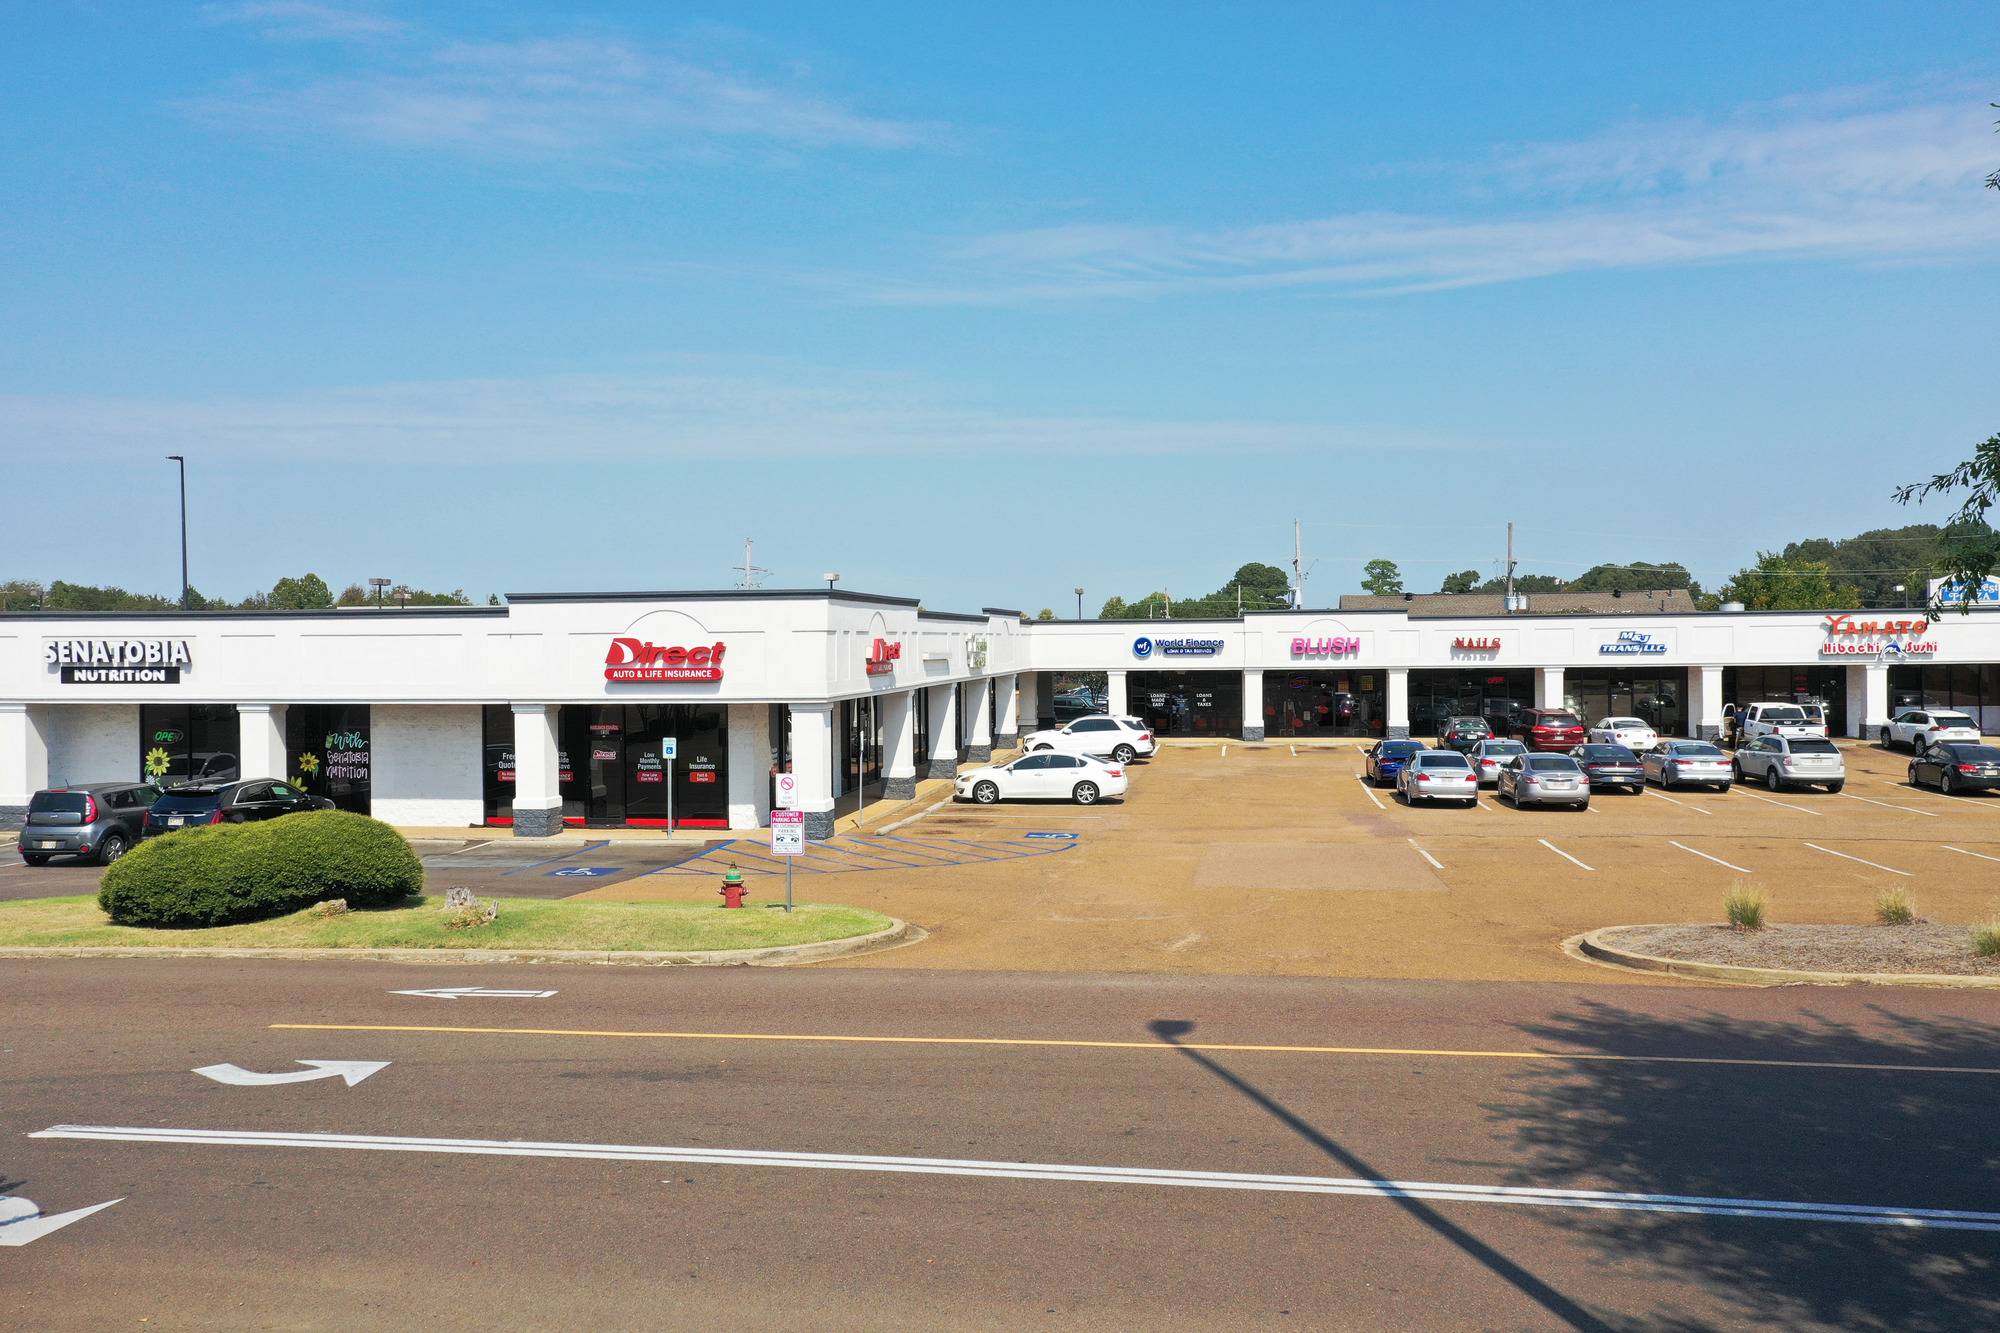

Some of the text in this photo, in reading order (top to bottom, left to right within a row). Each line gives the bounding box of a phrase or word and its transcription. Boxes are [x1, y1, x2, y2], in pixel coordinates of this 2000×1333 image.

[1949, 592, 1990, 600] PLZA
[1825, 615, 1927, 635] YAMATO
[1155, 639, 1224, 647] World Finance
[1455, 637, 1501, 649] NAILS
[1620, 631, 1651, 643] M&J
[605, 638, 726, 664] Direct
[1292, 637, 1360, 654] BLUSH
[1823, 641, 1938, 653] Hibachi Sushi
[43, 641, 191, 663] SENATOBIA
[74, 669, 165, 681] NUTRITION
[613, 670, 635, 678] AUTO
[645, 670, 662, 678] LIFE
[665, 670, 712, 678] INSURANCE
